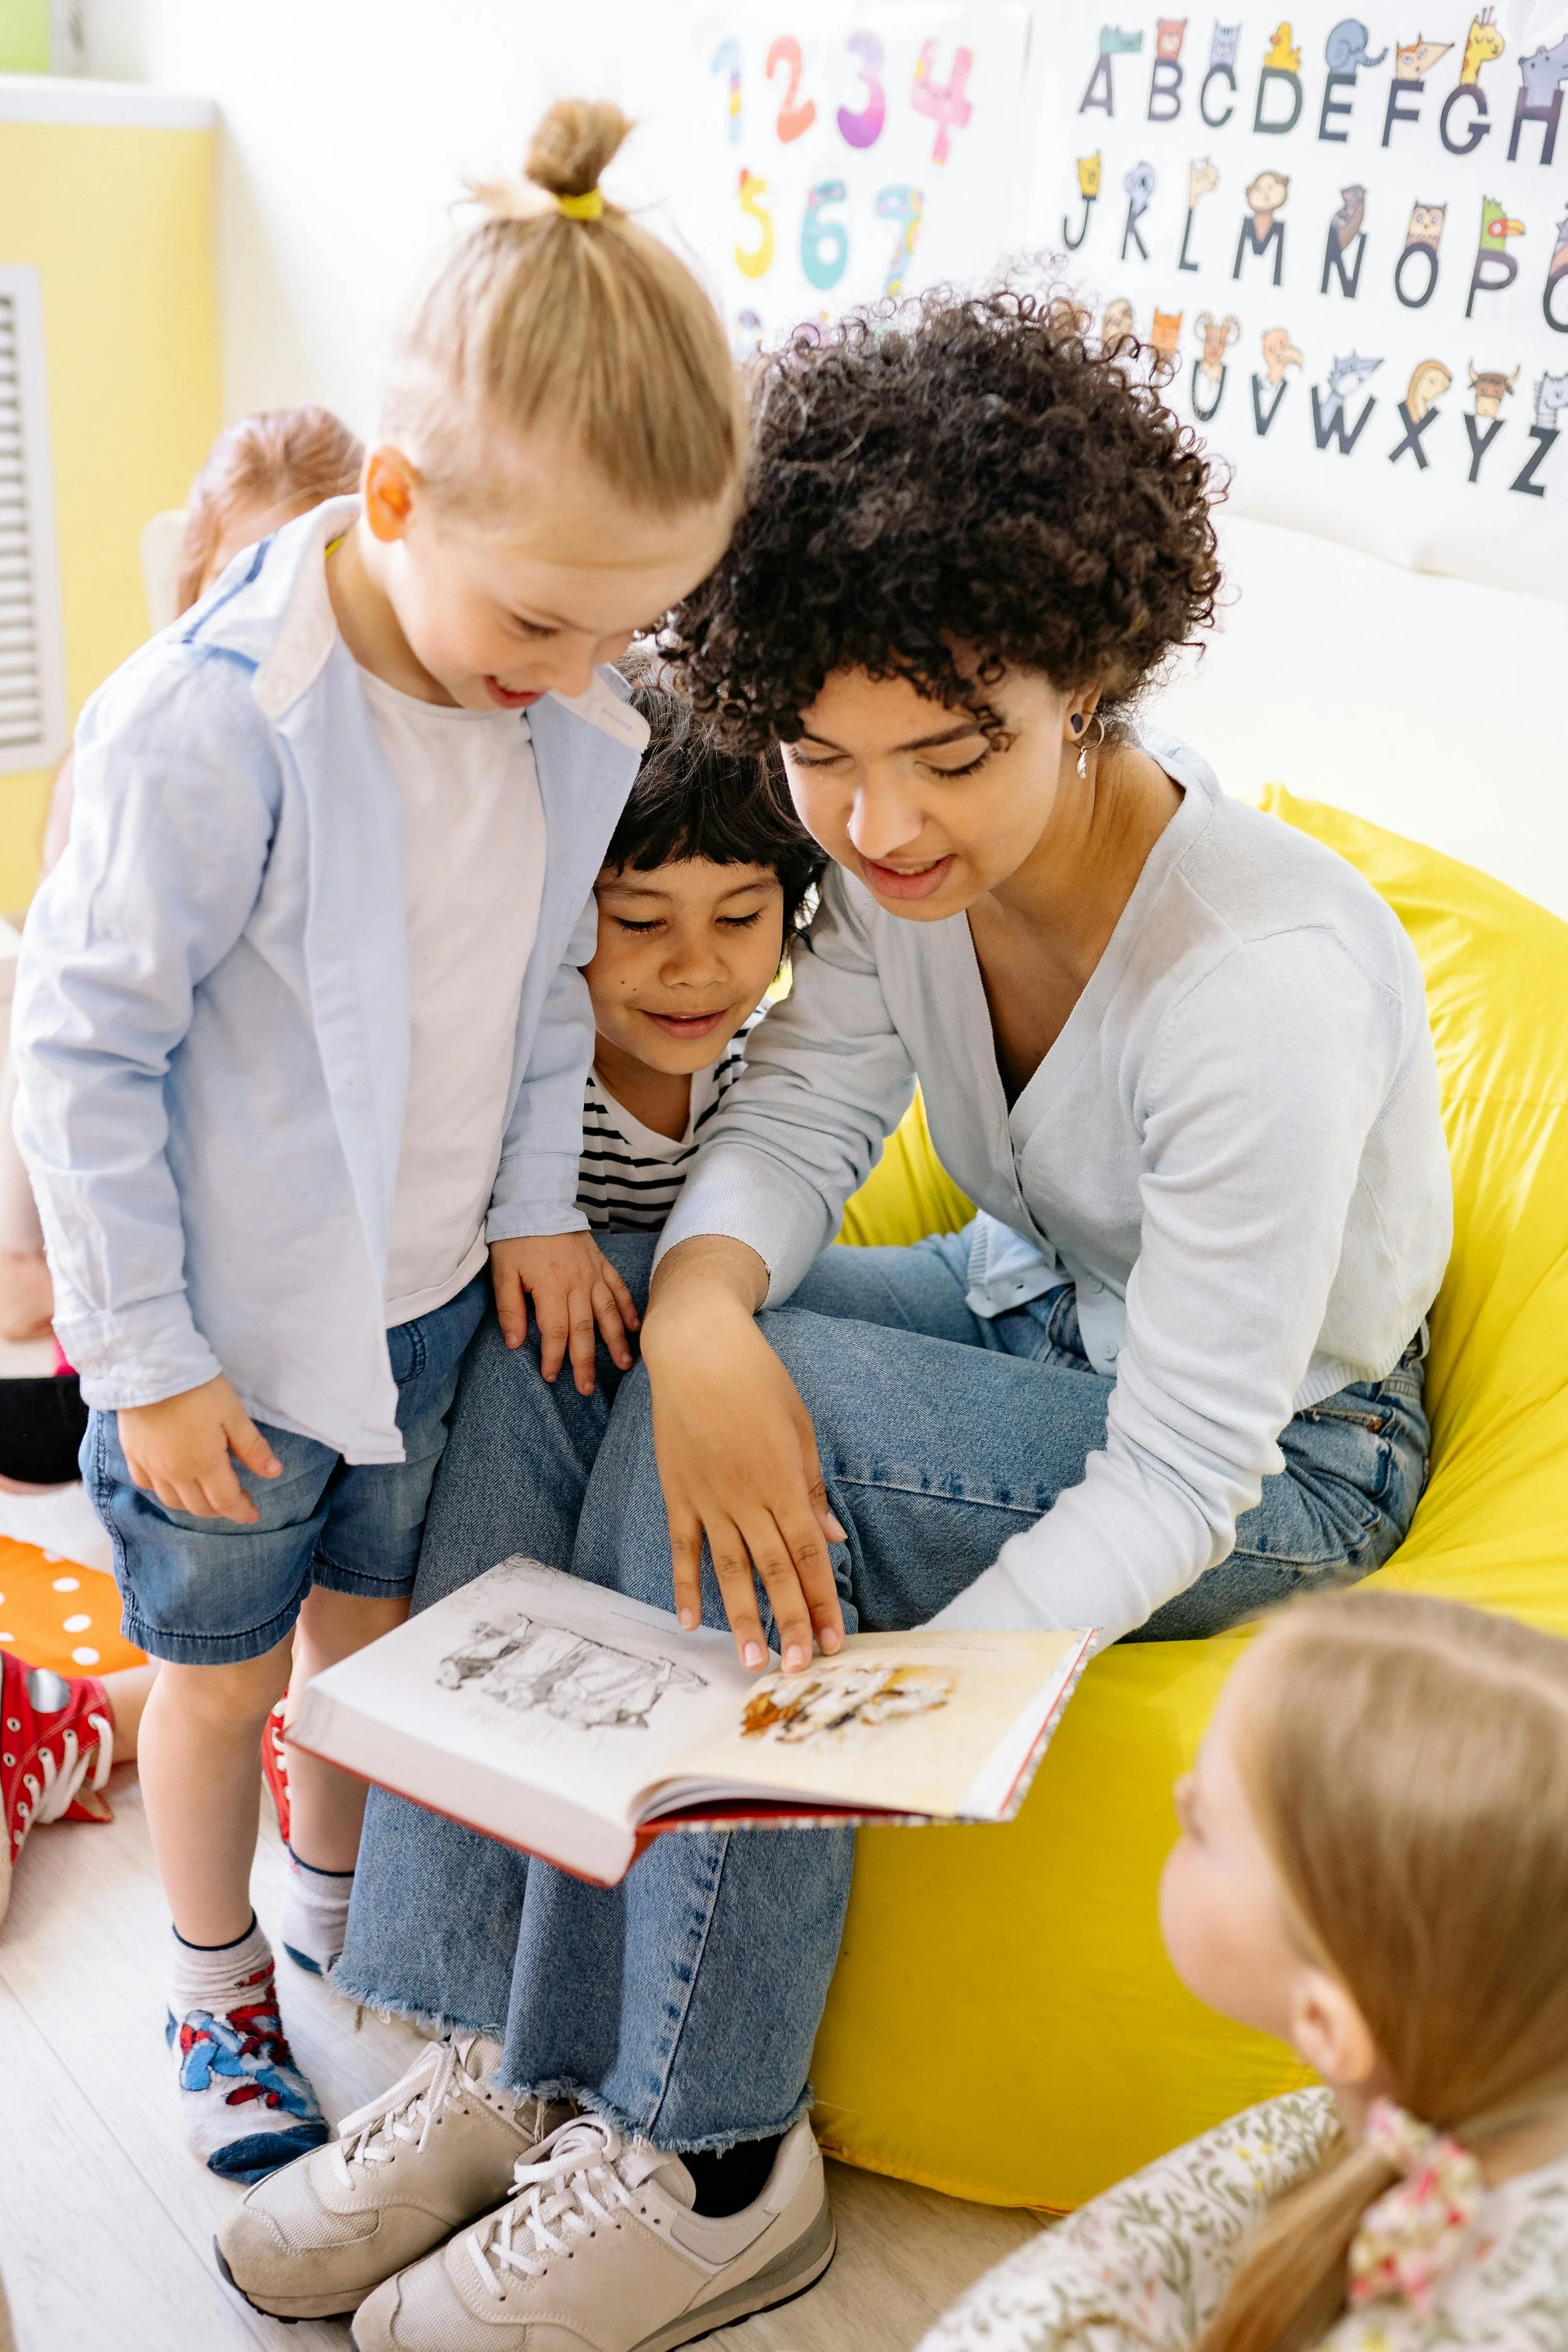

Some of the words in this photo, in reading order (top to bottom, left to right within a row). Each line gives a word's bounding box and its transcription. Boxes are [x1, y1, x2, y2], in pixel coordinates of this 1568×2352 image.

[711, 34, 742, 144] 1
[765, 34, 816, 144] 2
[837, 30, 886, 149] 3
[911, 38, 973, 166] 4
[1079, 53, 1113, 117] A
[1148, 58, 1183, 121] B
[1200, 64, 1236, 126] C
[1254, 68, 1303, 134] D
[1318, 73, 1357, 142] E
[1382, 79, 1424, 147] F
[1440, 84, 1490, 155] G
[1507, 87, 1564, 165] H
[734, 168, 774, 278] 5
[800, 179, 848, 290] 6
[876, 184, 923, 297] 7
[1064, 194, 1097, 250] J
[1121, 196, 1148, 260] K
[1179, 206, 1199, 272] L
[1233, 216, 1285, 286] M
[1321, 223, 1366, 299] N
[1395, 242, 1438, 308] O
[1465, 248, 1518, 318] P
[1192, 360, 1227, 422] U
[1252, 374, 1286, 436] V
[1311, 384, 1375, 455] W
[1388, 401, 1439, 469] X
[1464, 413, 1505, 482] Y
[1509, 425, 1560, 497] Z
